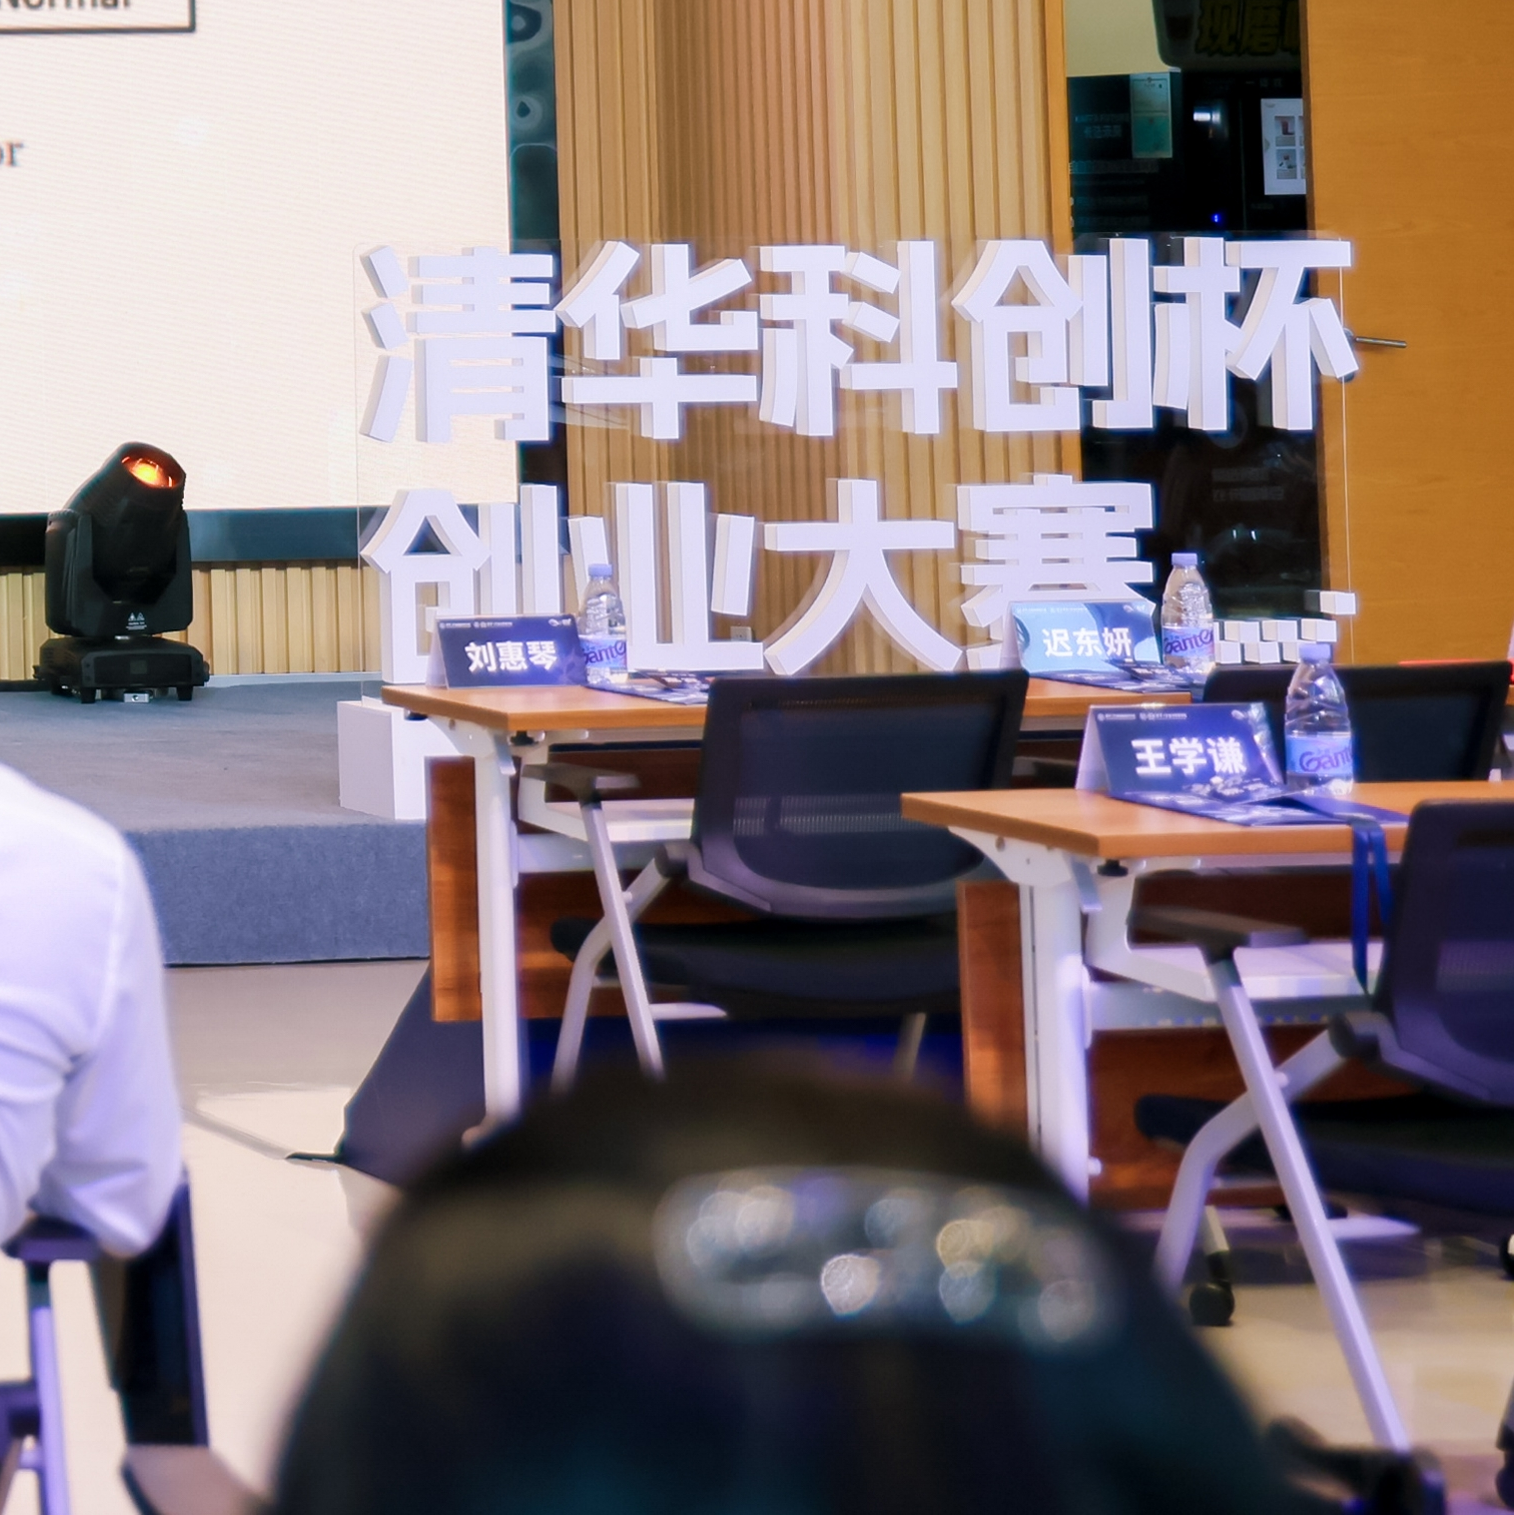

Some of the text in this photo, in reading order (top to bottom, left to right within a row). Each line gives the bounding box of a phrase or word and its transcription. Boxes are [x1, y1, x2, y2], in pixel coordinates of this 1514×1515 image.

[359, 236, 1360, 443] 清华科创杯
[359, 473, 1157, 684] 创业大赛
[464, 640, 558, 673] 刘惠琴
[1042, 627, 1133, 658] 迟东妍
[1130, 736, 1247, 777] 王学谦
